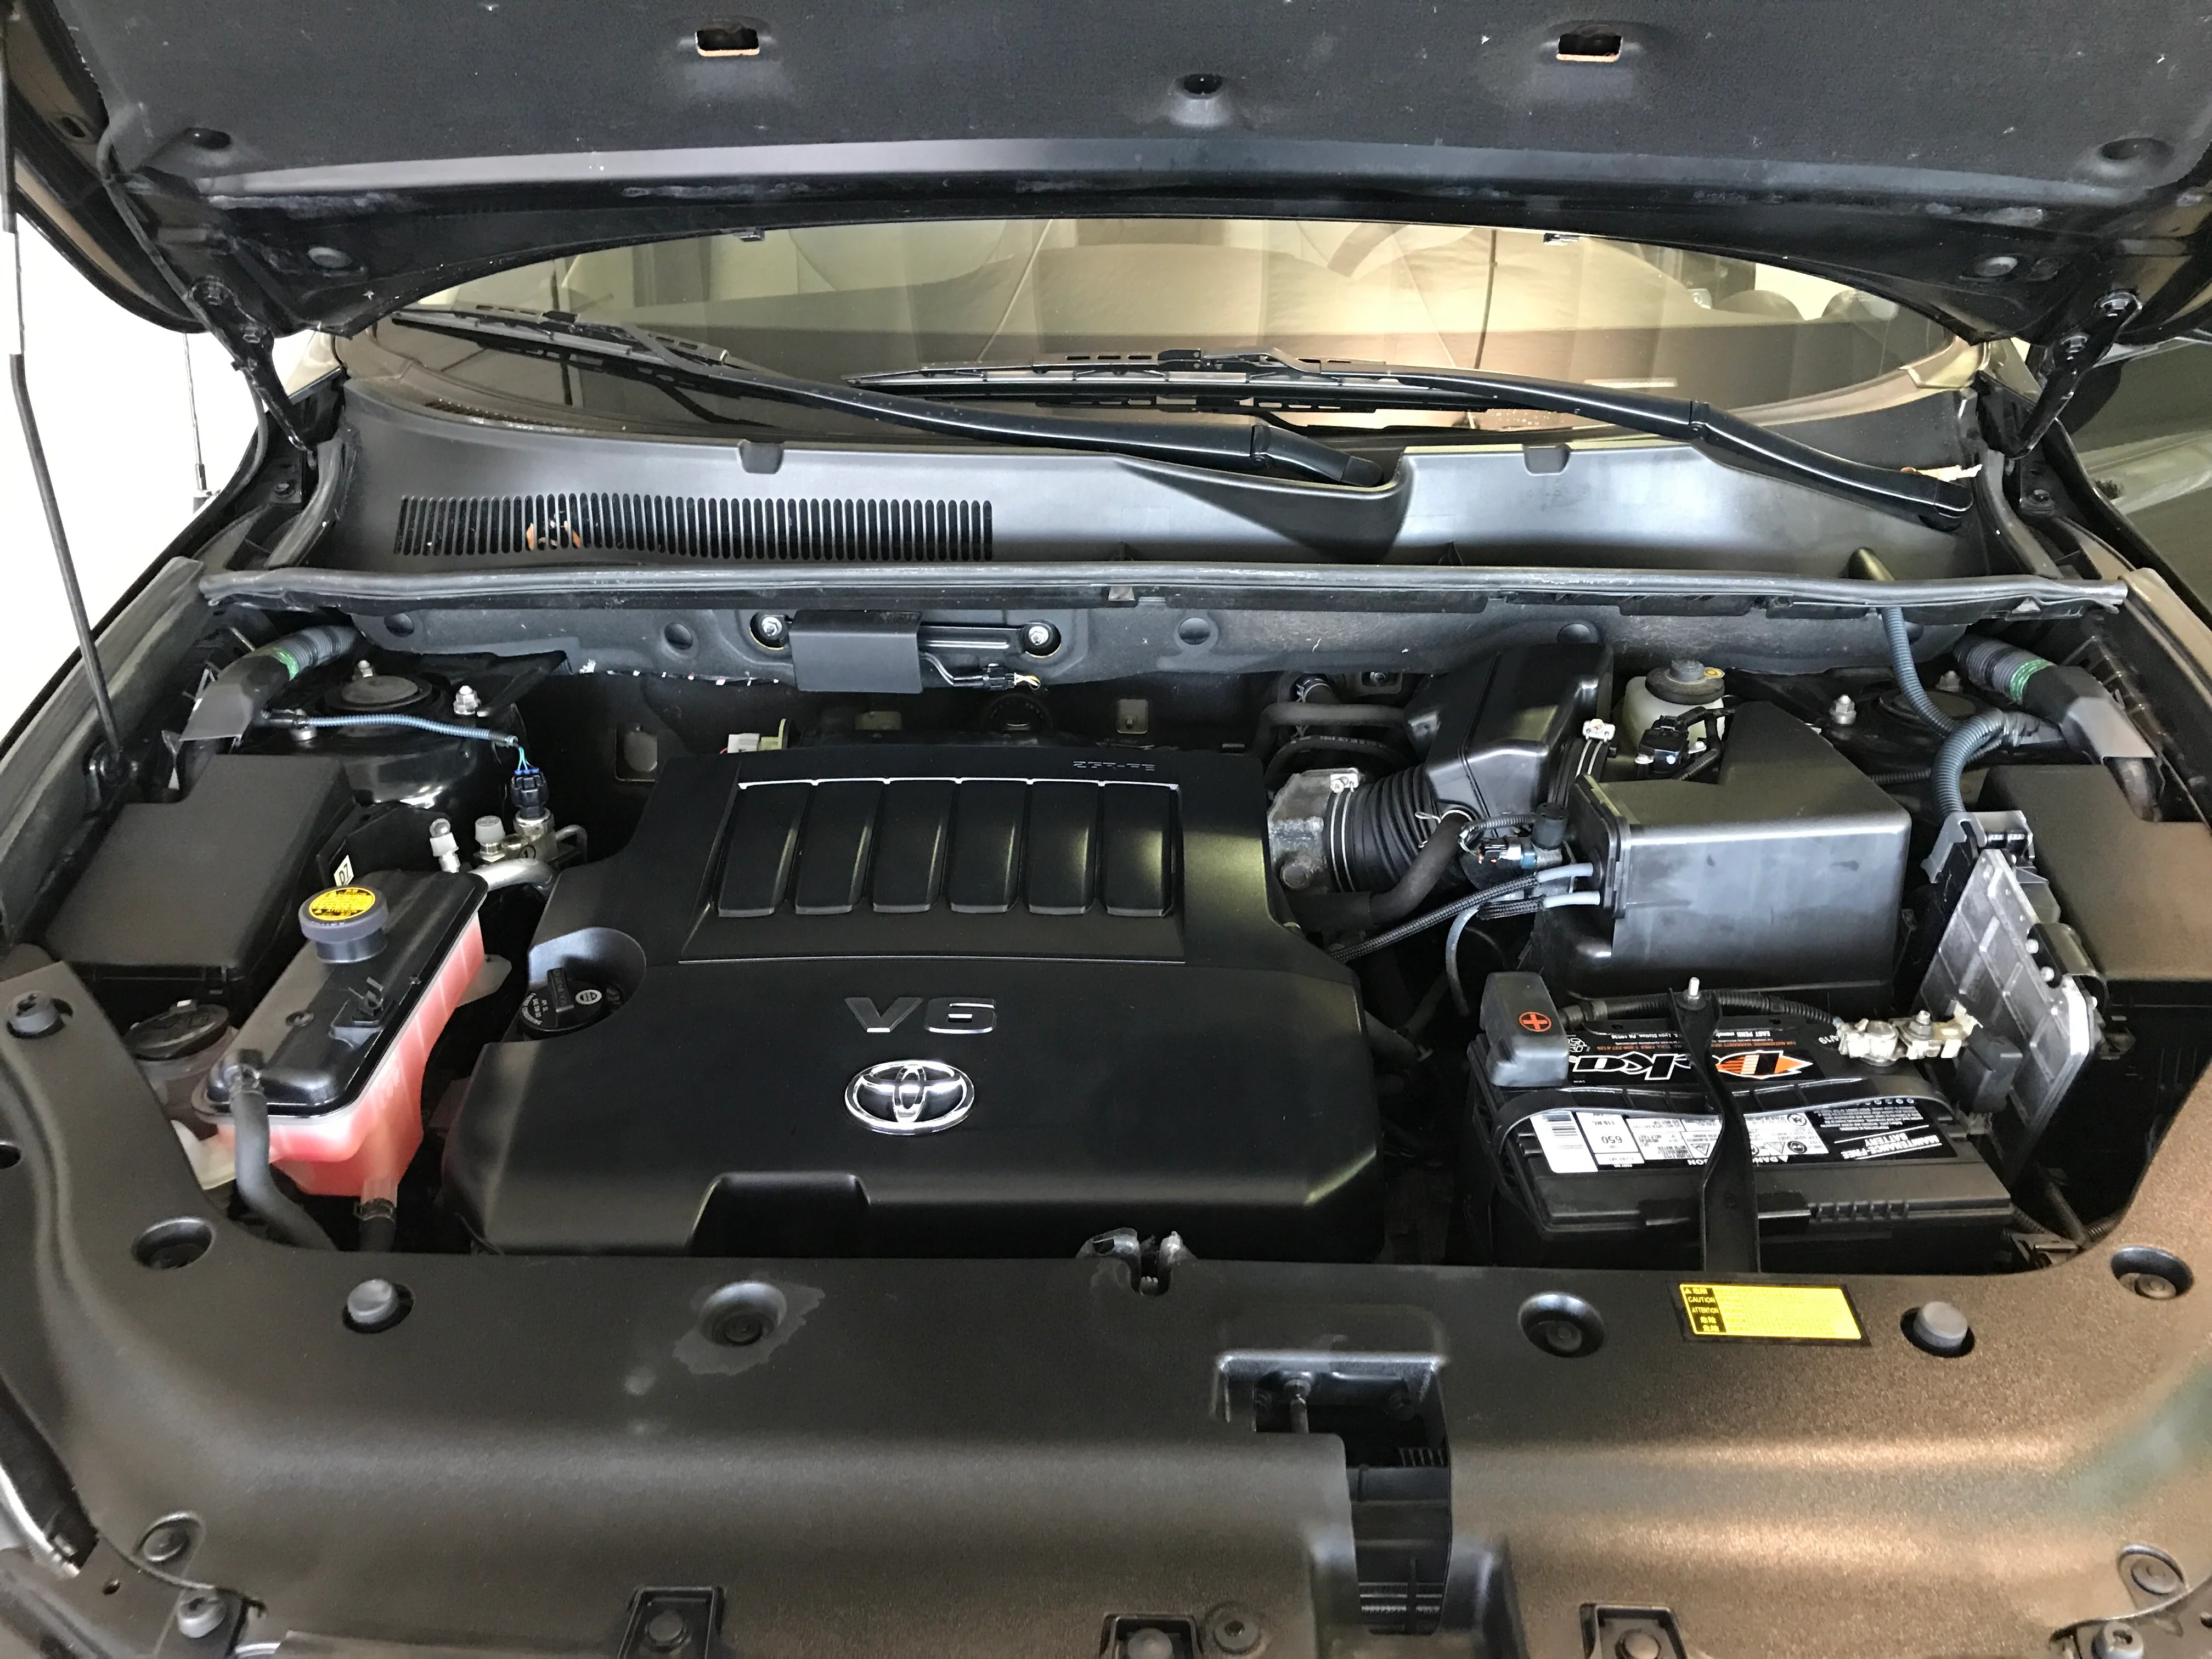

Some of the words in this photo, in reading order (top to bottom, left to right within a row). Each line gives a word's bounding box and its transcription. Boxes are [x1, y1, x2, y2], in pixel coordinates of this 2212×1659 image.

[844, 996, 997, 1034] V6
[1601, 1136, 1623, 1144] 650
[1840, 1134, 1940, 1160] MAINTENANCE-FREE
[1864, 1132, 1909, 1147] BATTERY
